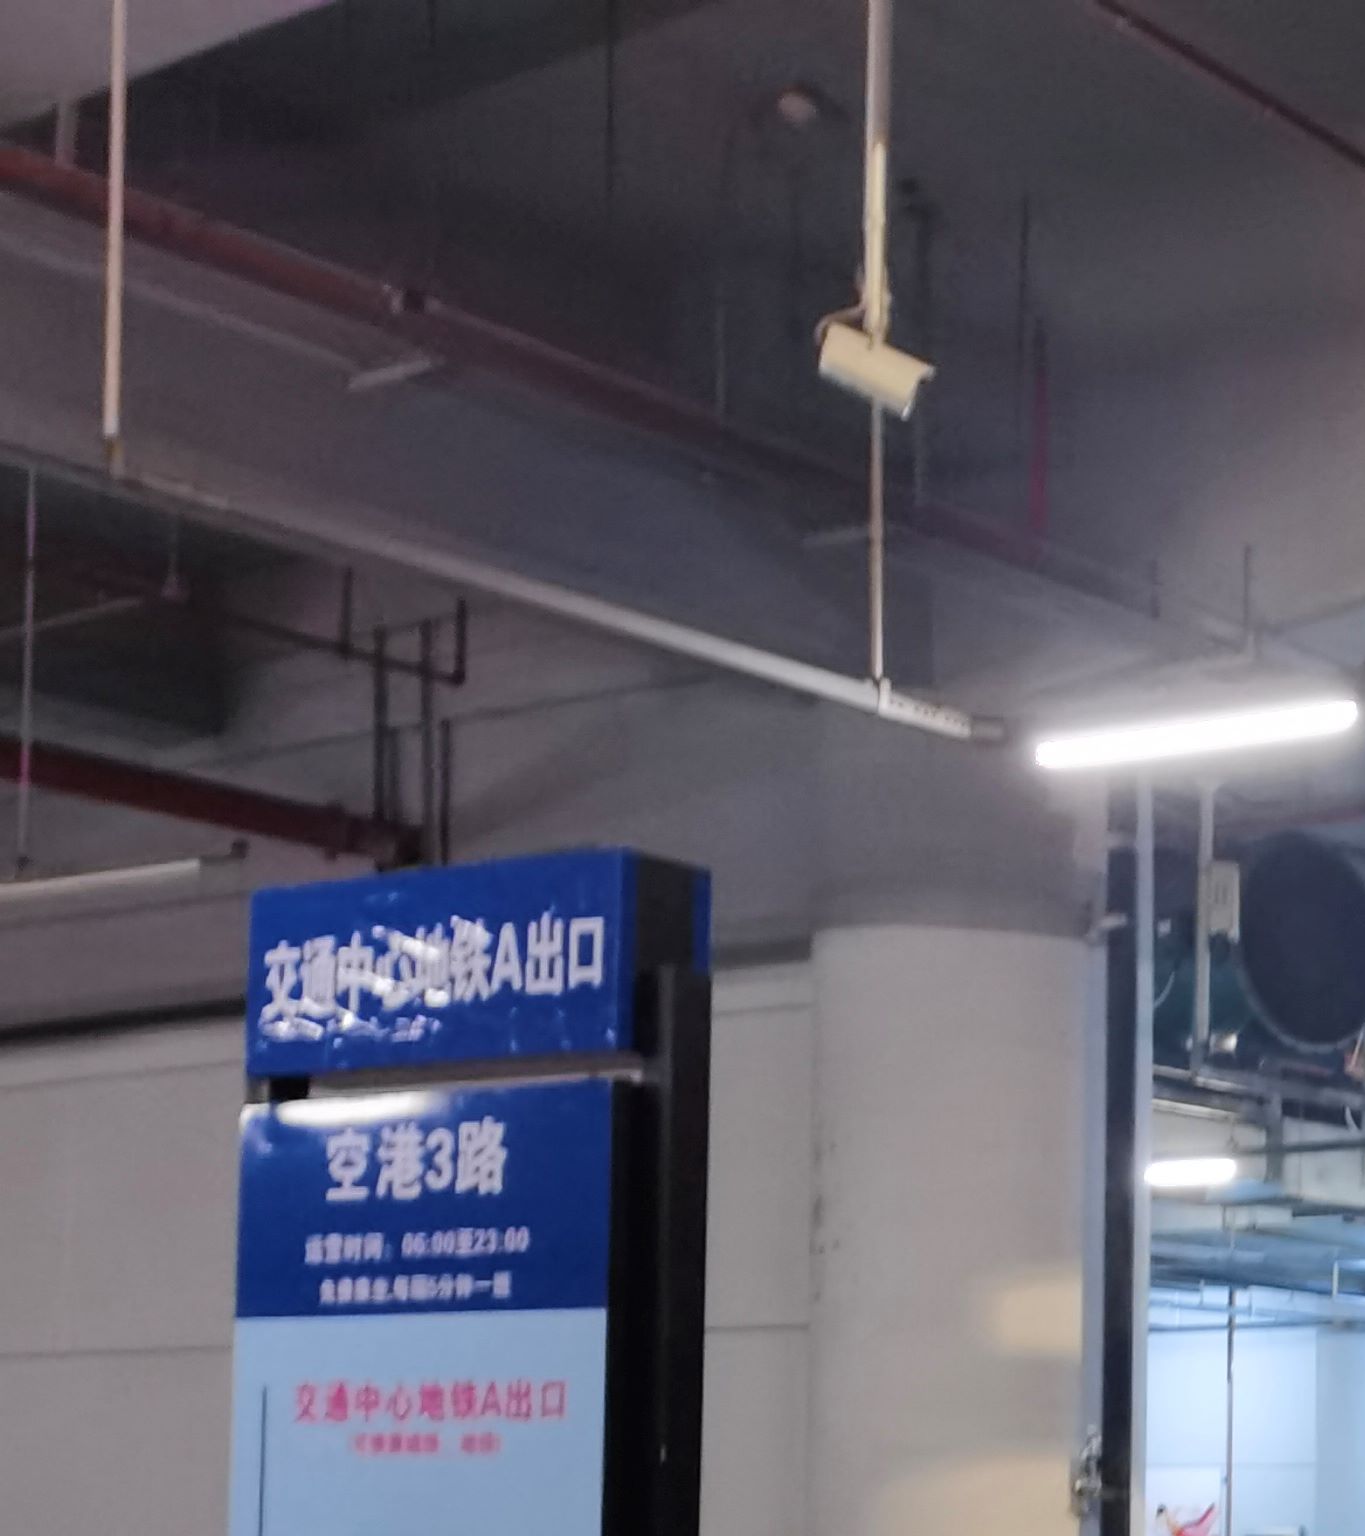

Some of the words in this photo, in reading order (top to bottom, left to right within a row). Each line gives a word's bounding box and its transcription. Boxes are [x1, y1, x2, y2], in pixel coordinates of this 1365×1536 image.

[326, 1117, 506, 1201] 空港3路
[295, 1380, 566, 1422] 交通中心地铁A出口
